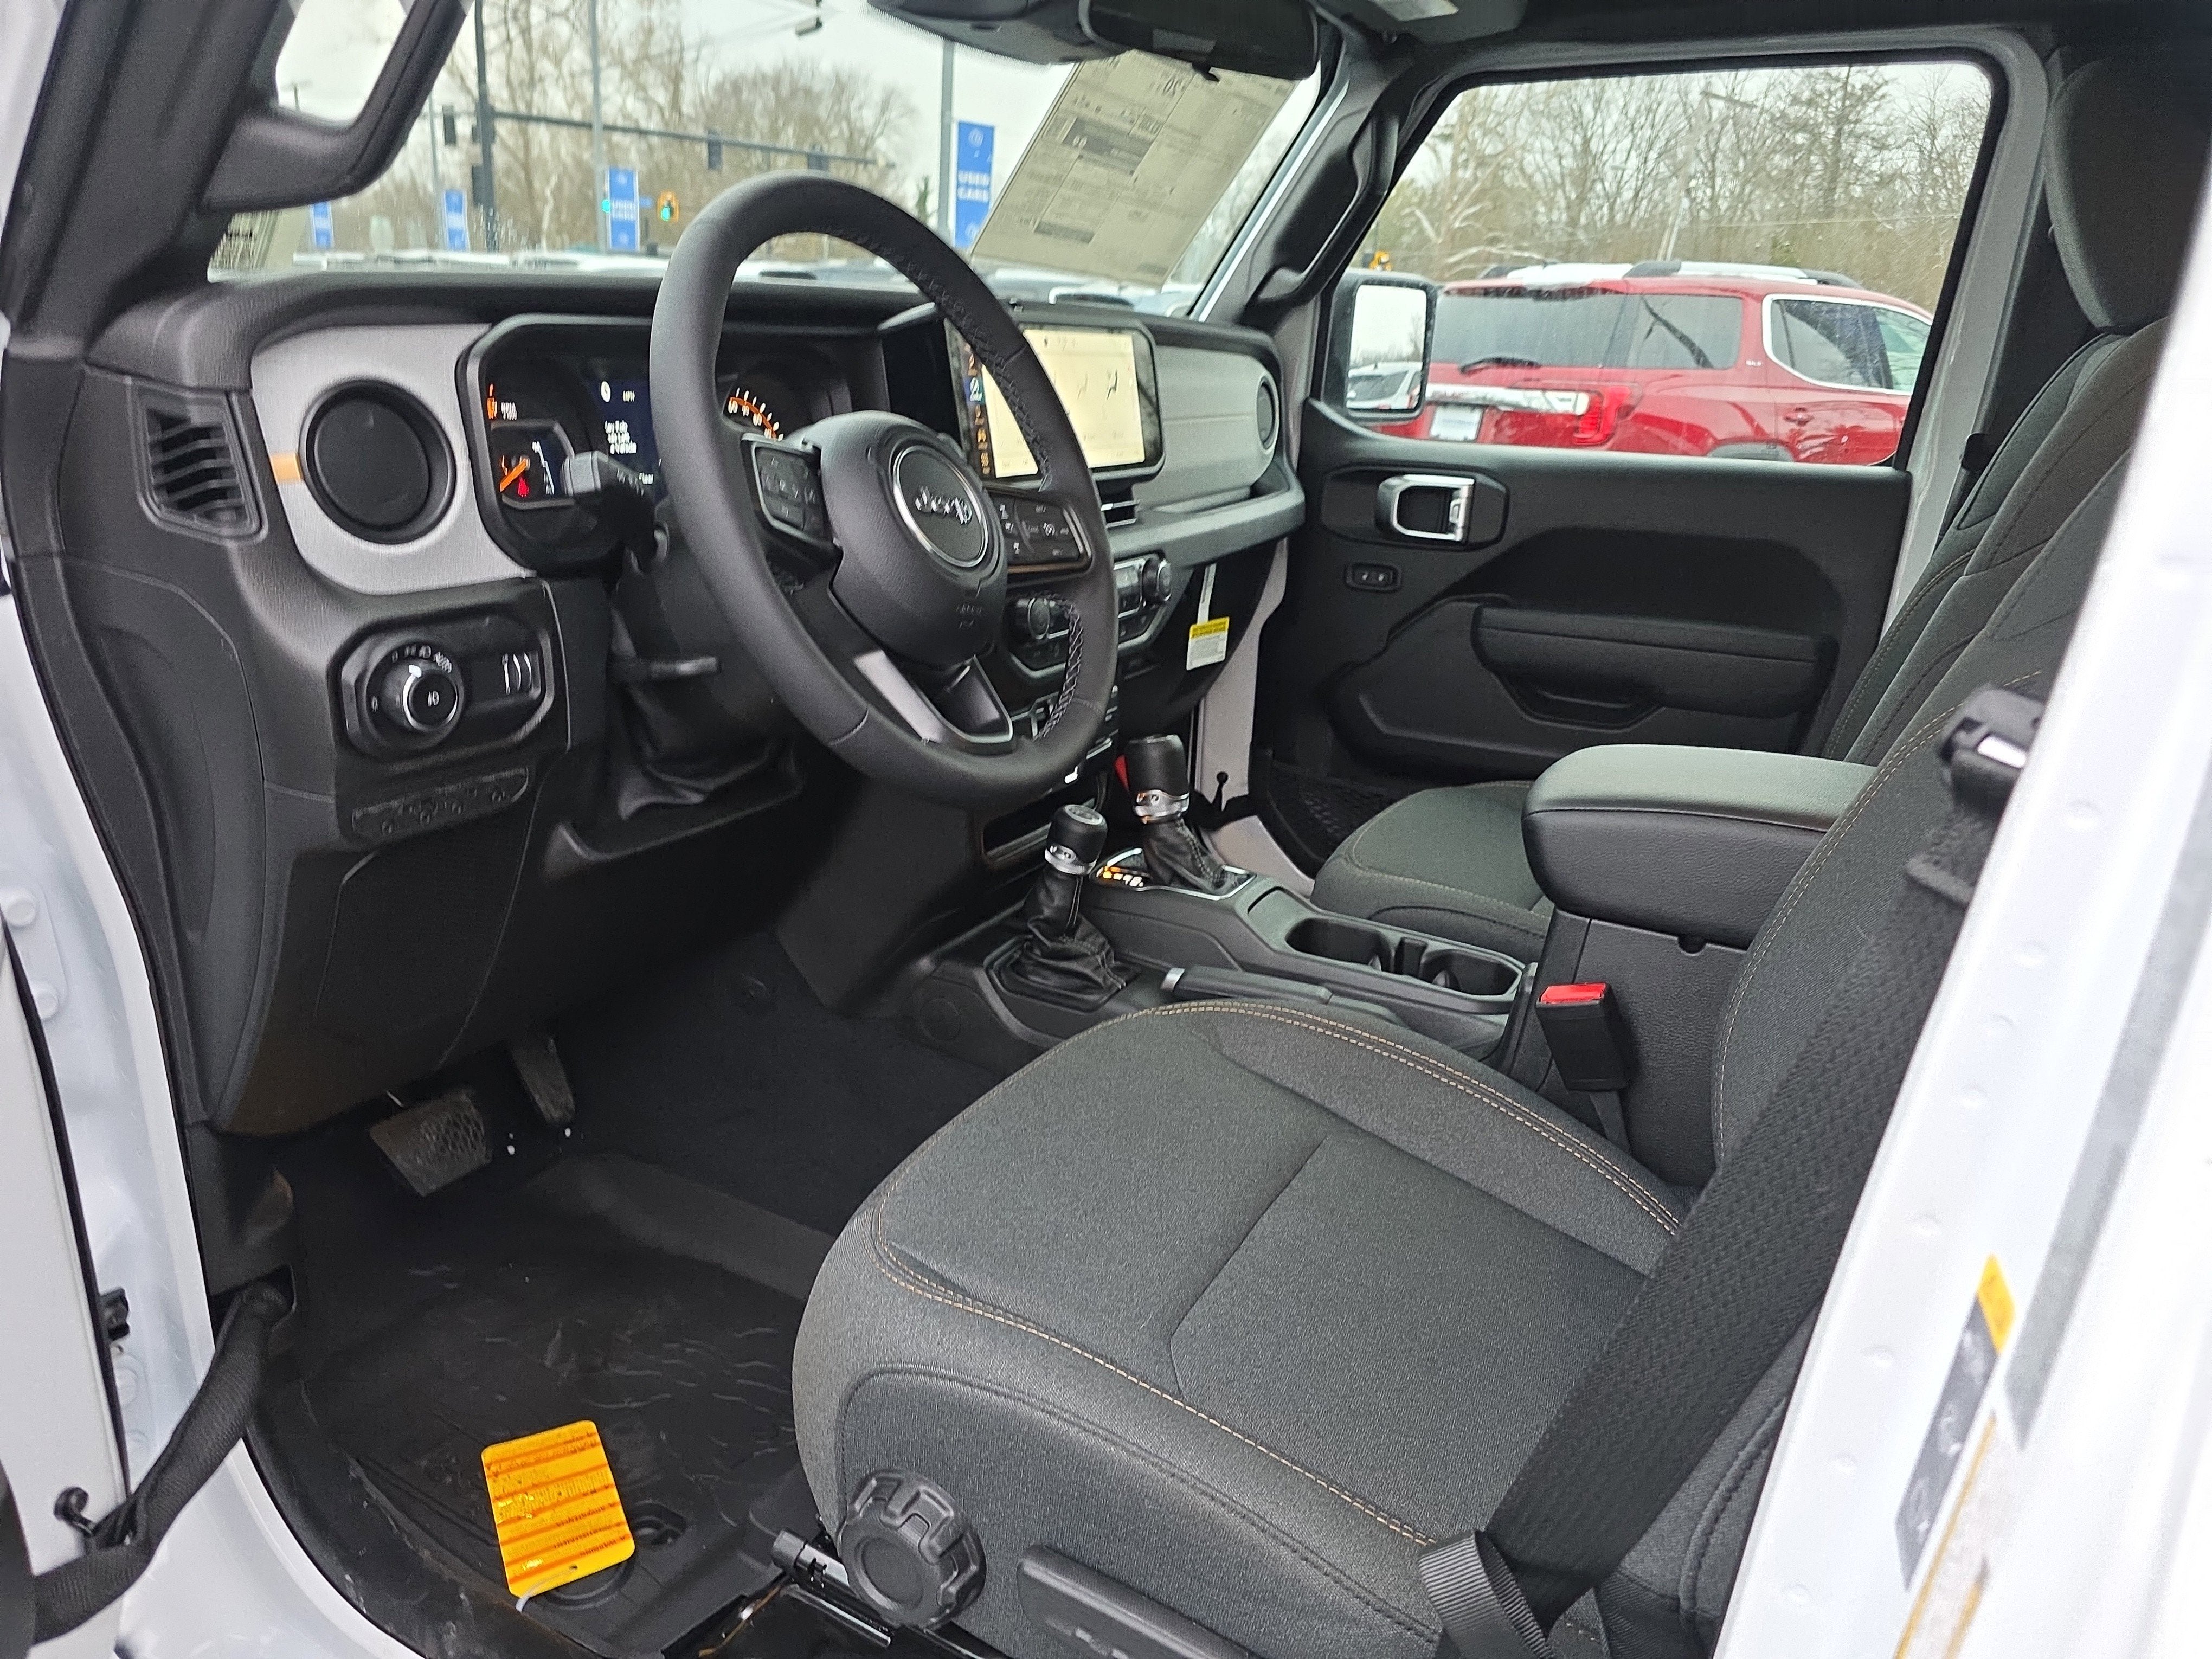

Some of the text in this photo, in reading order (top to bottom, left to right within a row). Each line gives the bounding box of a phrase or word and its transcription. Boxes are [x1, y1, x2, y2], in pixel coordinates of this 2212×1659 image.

[958, 170, 990, 187] USED
[957, 186, 989, 203] CARS
[915, 486, 972, 525] Jeep
[433, 652, 452, 673] AUTO
[580, 1539, 616, 1557] WARNING
